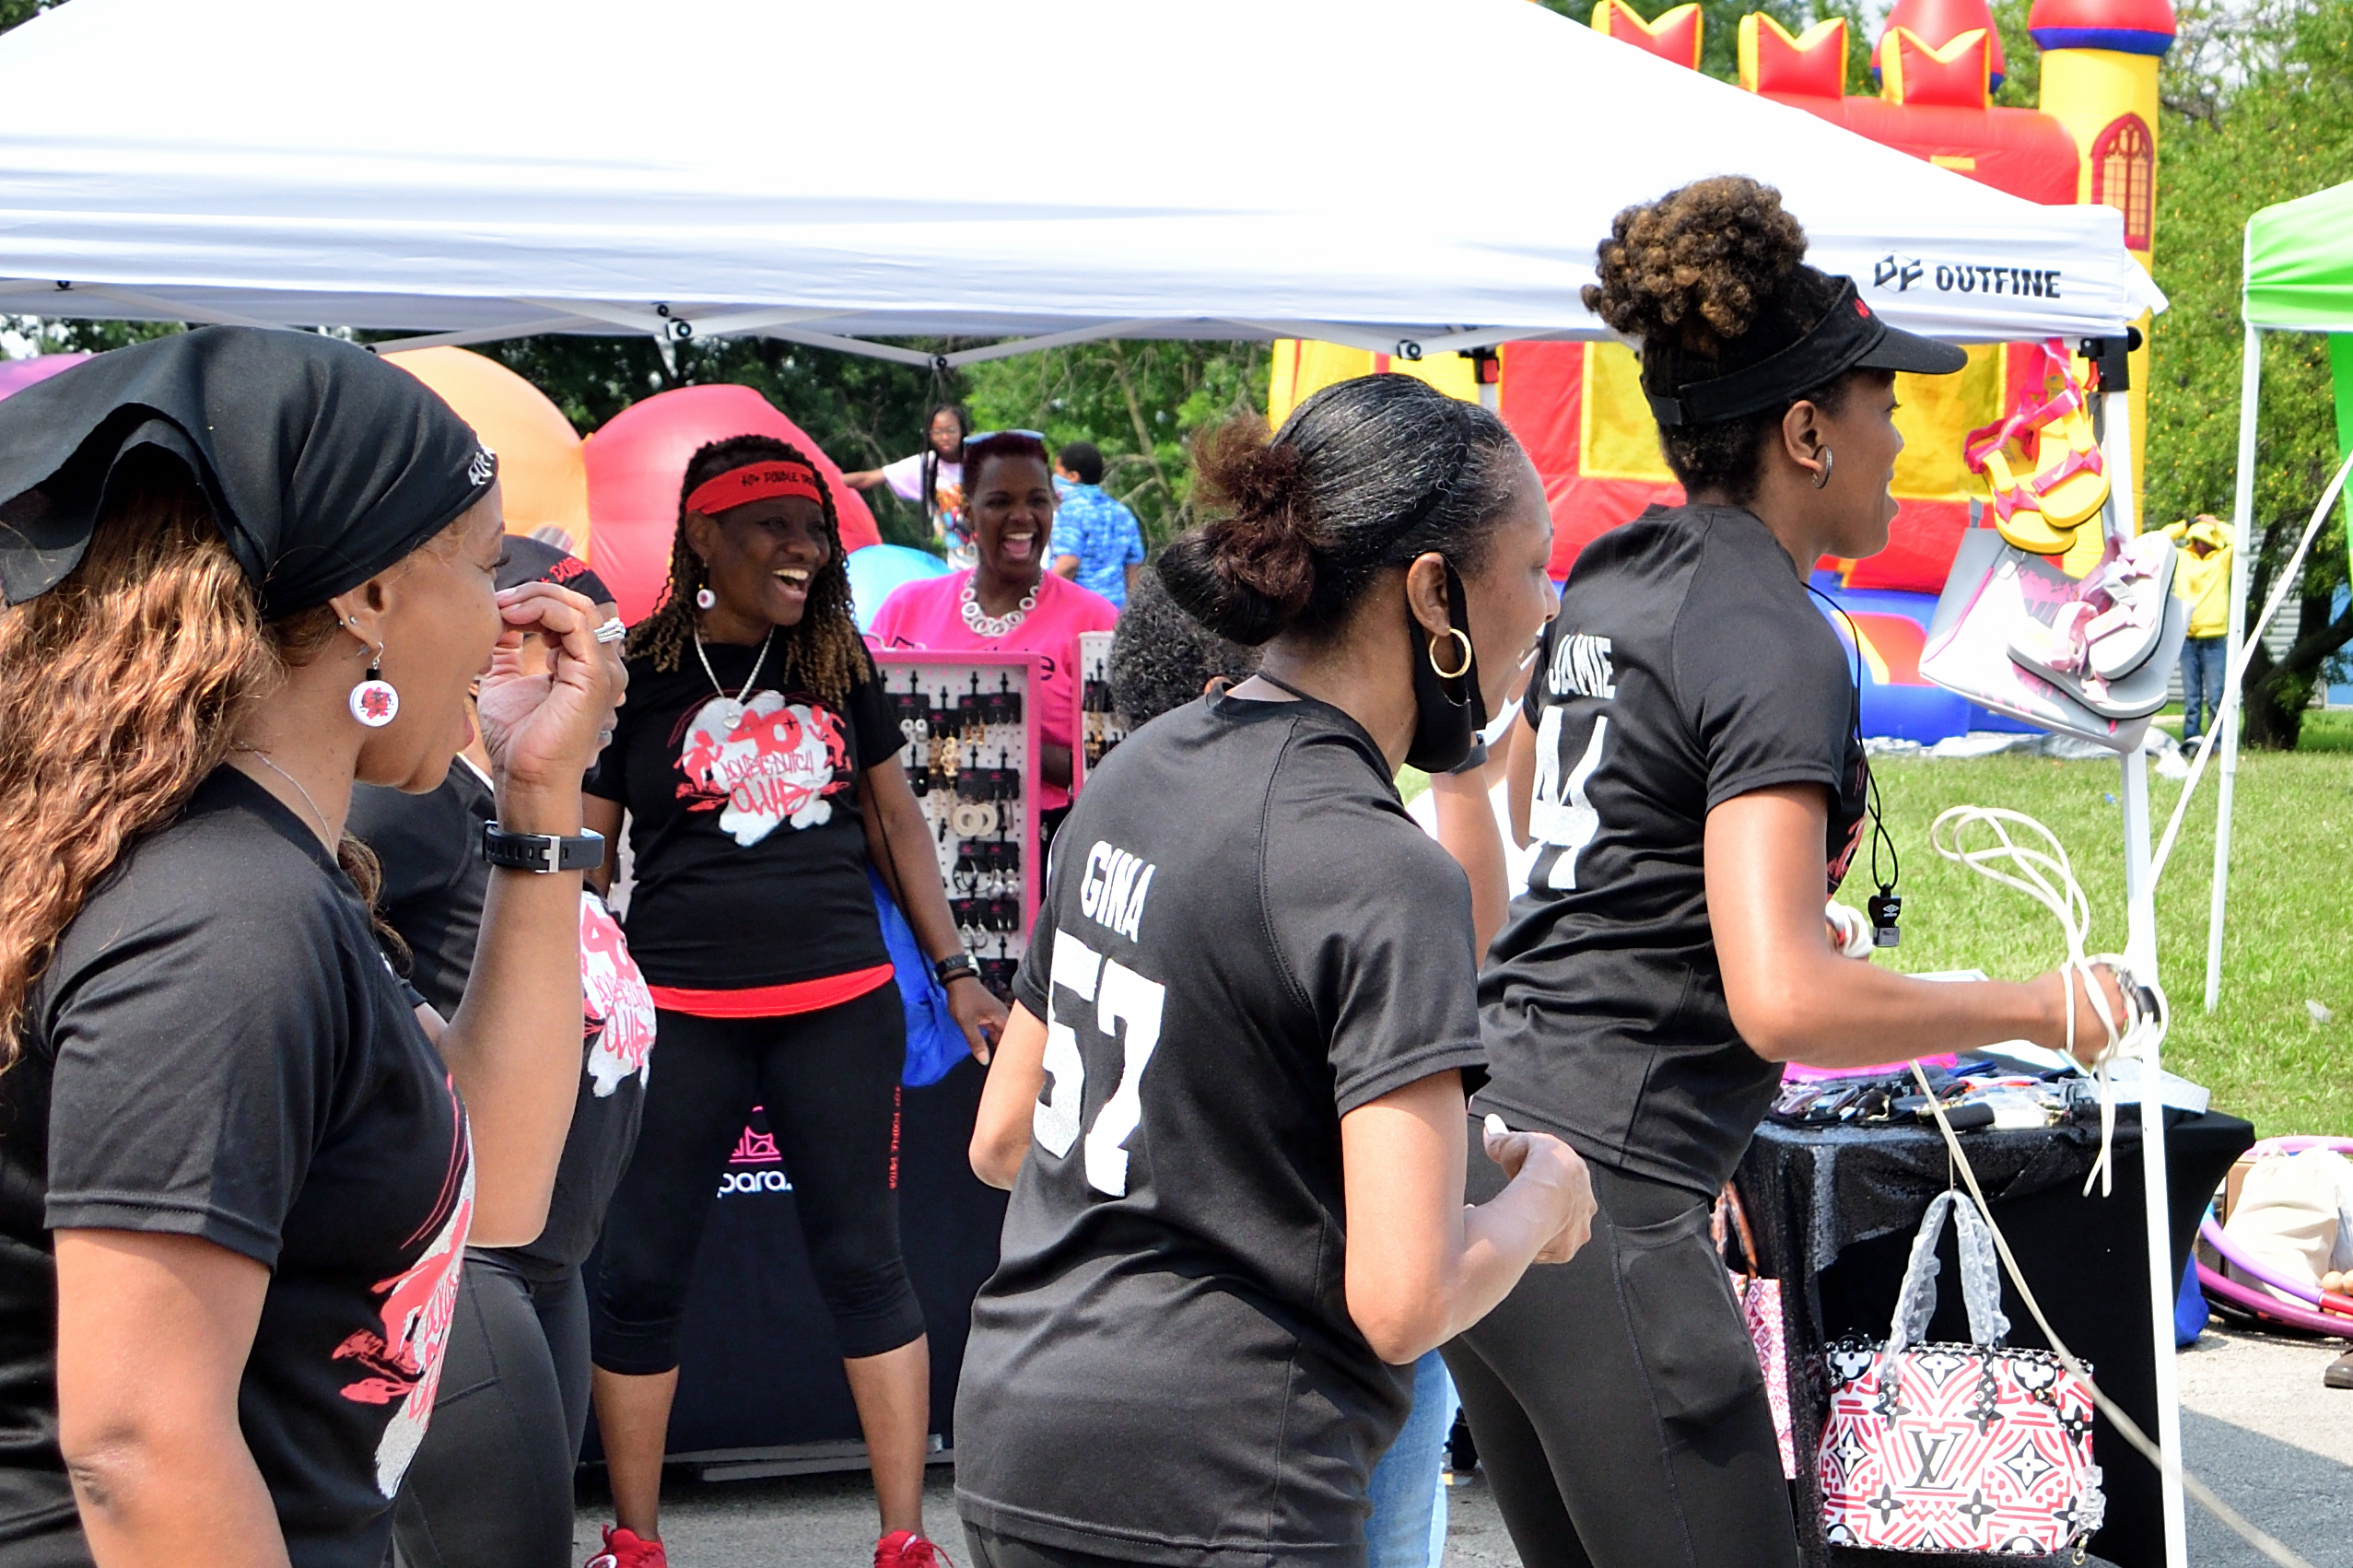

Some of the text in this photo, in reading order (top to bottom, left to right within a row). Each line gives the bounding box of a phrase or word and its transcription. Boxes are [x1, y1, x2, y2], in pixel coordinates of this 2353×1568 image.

[1936, 264, 2061, 298] OUTFINE
[730, 778, 814, 821] CLUB
[1081, 840, 1156, 943] GINA
[1033, 927, 1166, 1198] 57
[717, 1171, 792, 1199] para
[1904, 1430, 1963, 1490] LV
